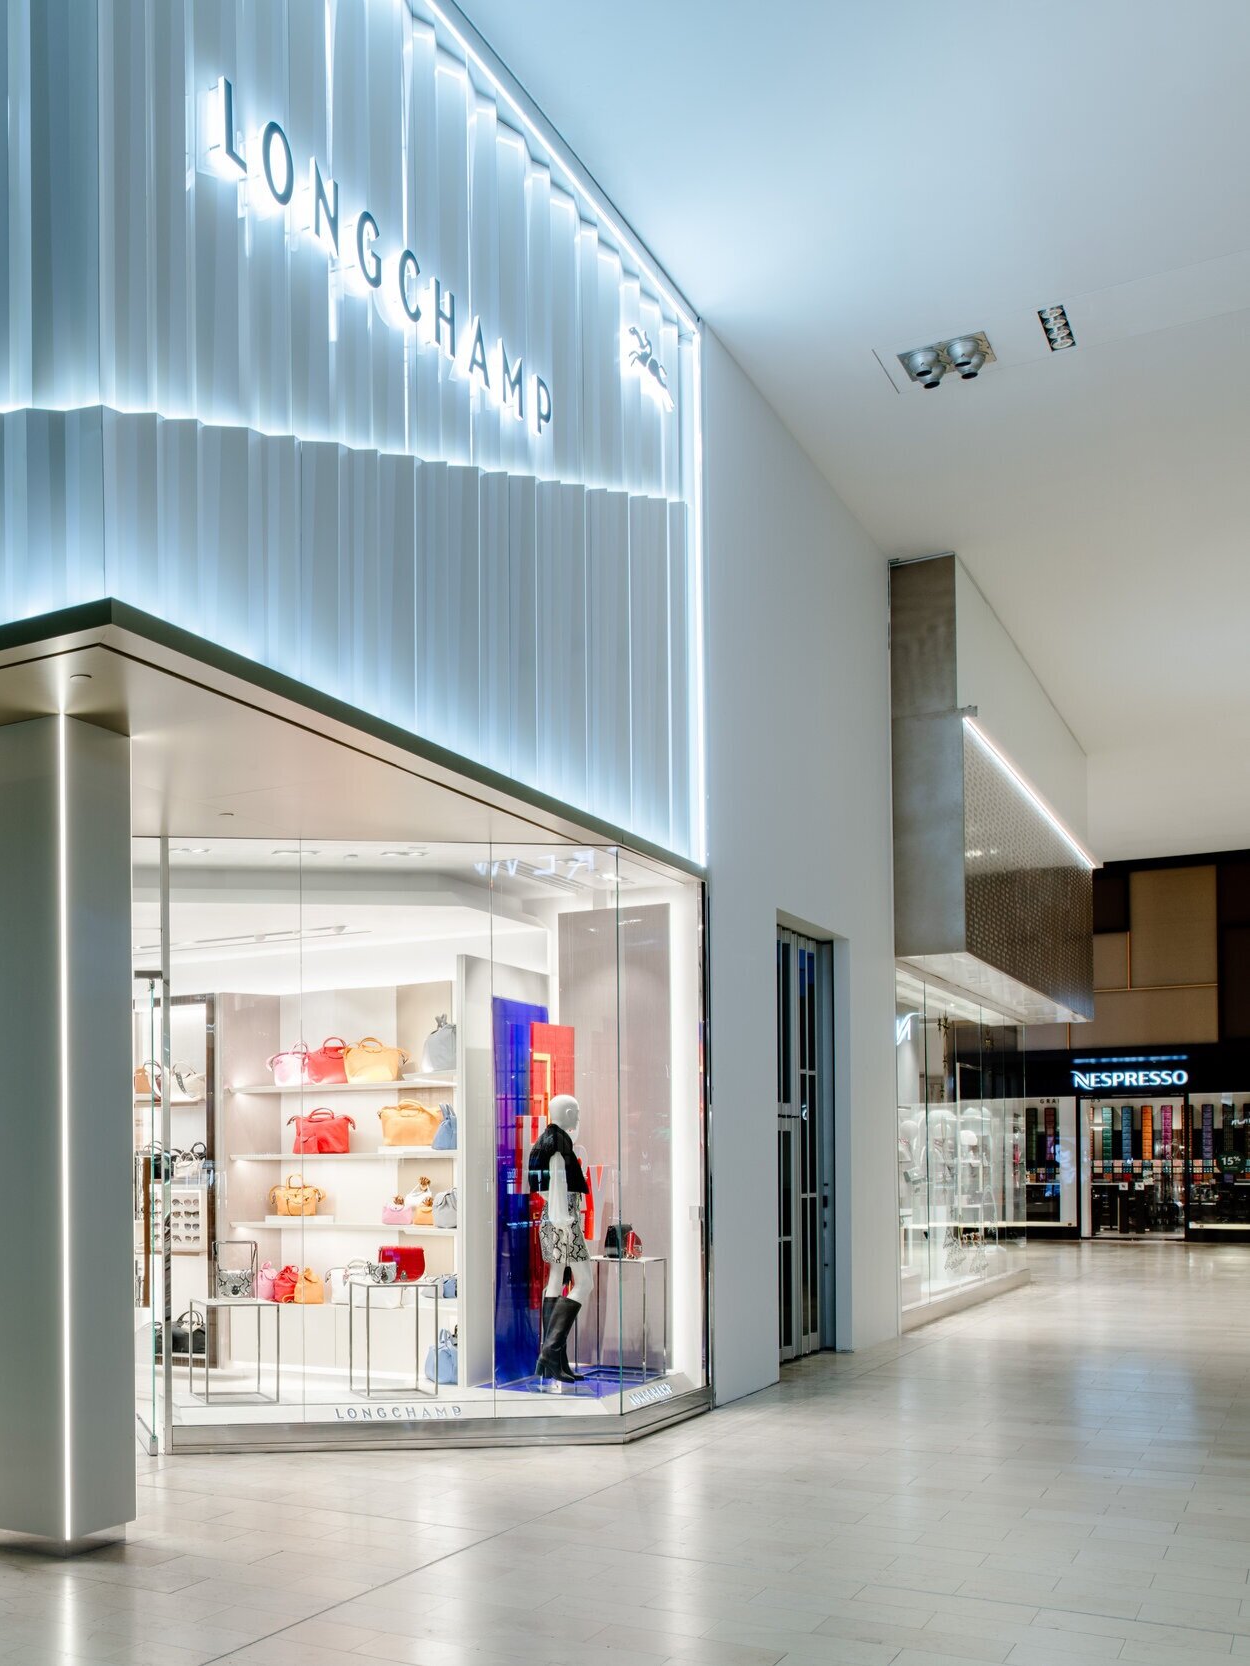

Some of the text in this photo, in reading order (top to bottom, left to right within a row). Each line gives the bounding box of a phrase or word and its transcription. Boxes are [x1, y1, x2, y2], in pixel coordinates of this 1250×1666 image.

[218, 76, 551, 436] LONGCHAMP
[1070, 1069, 1189, 1090] NESPRESSO
[1221, 1155, 1241, 1166] 15%
[335, 1405, 462, 1420] LONGCHAMP
